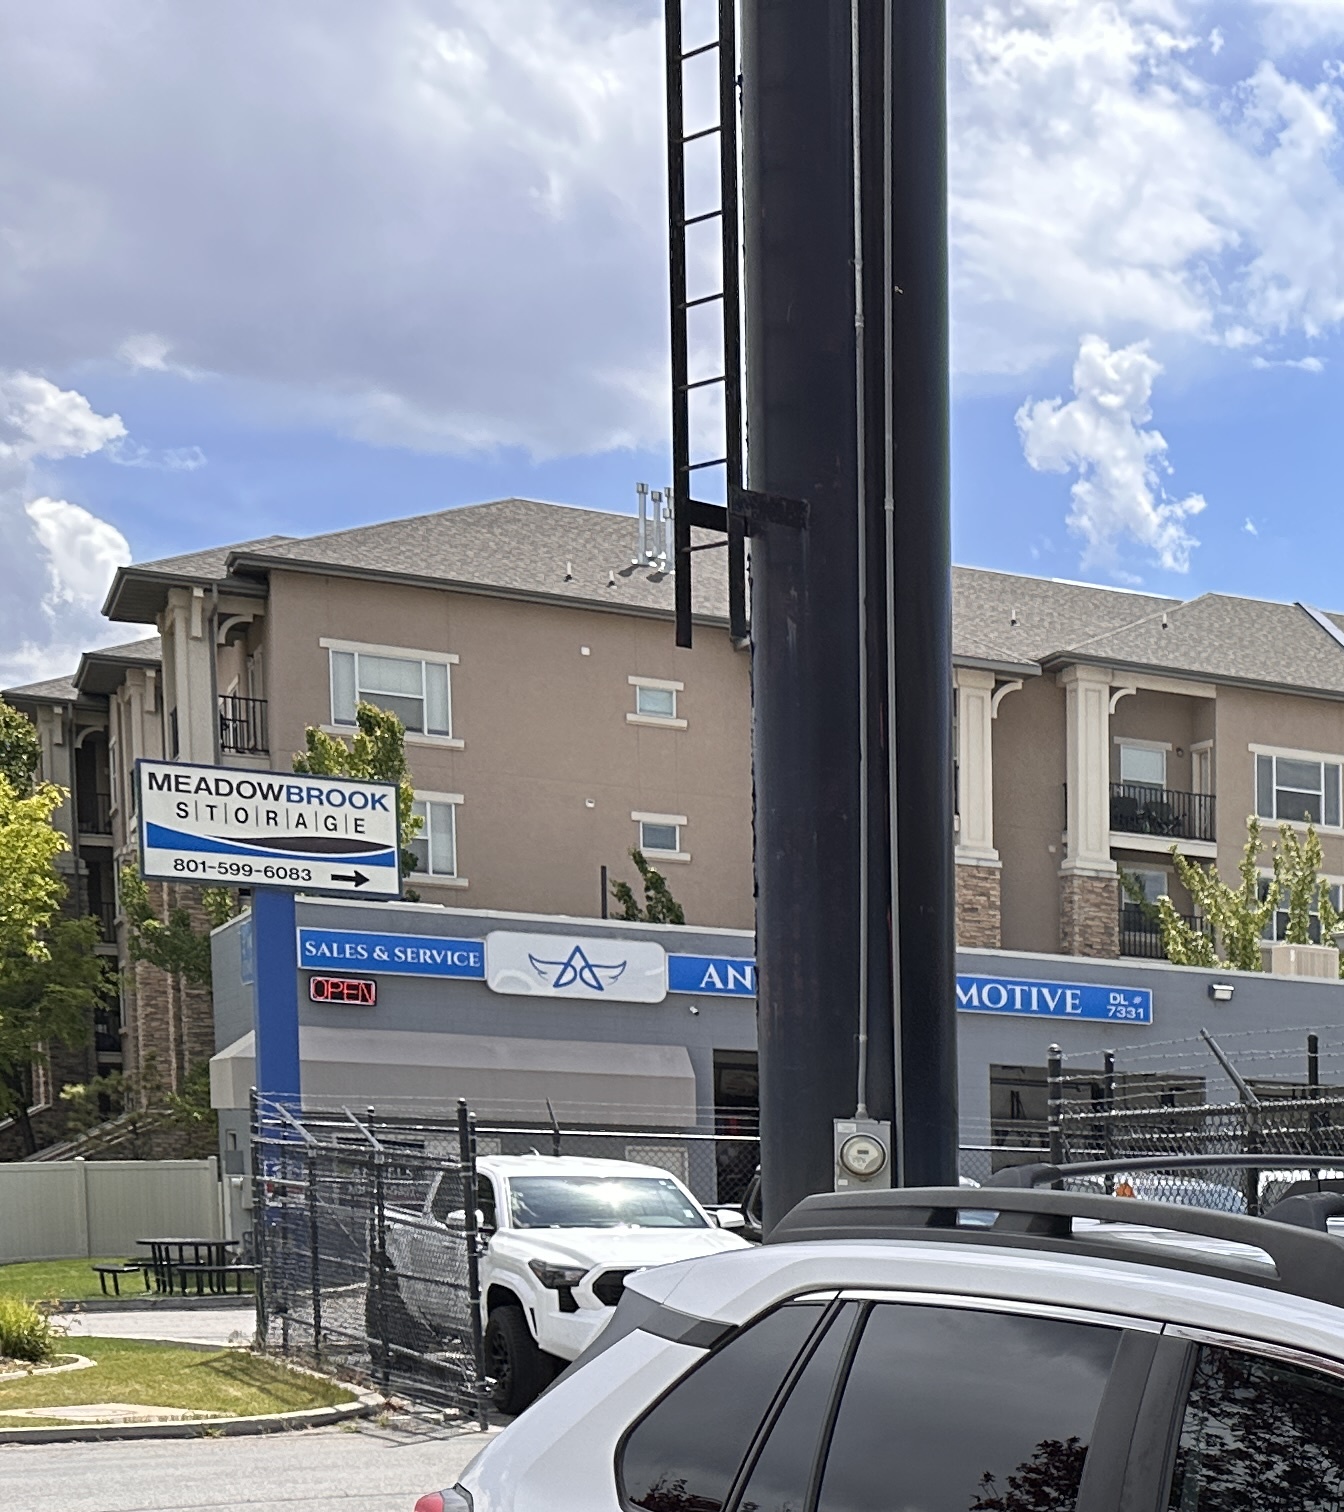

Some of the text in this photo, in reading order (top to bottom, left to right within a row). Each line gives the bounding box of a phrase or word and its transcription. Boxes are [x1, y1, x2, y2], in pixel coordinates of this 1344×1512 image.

[147, 771, 390, 813] MEADOWBROOK
[173, 857, 313, 882] 801-599-6083
[305, 940, 481, 968] SALES & SERVICE
[313, 978, 375, 1004] OPEN
[1109, 992, 1129, 1005] DL
[1106, 1004, 1145, 1020] 7331
